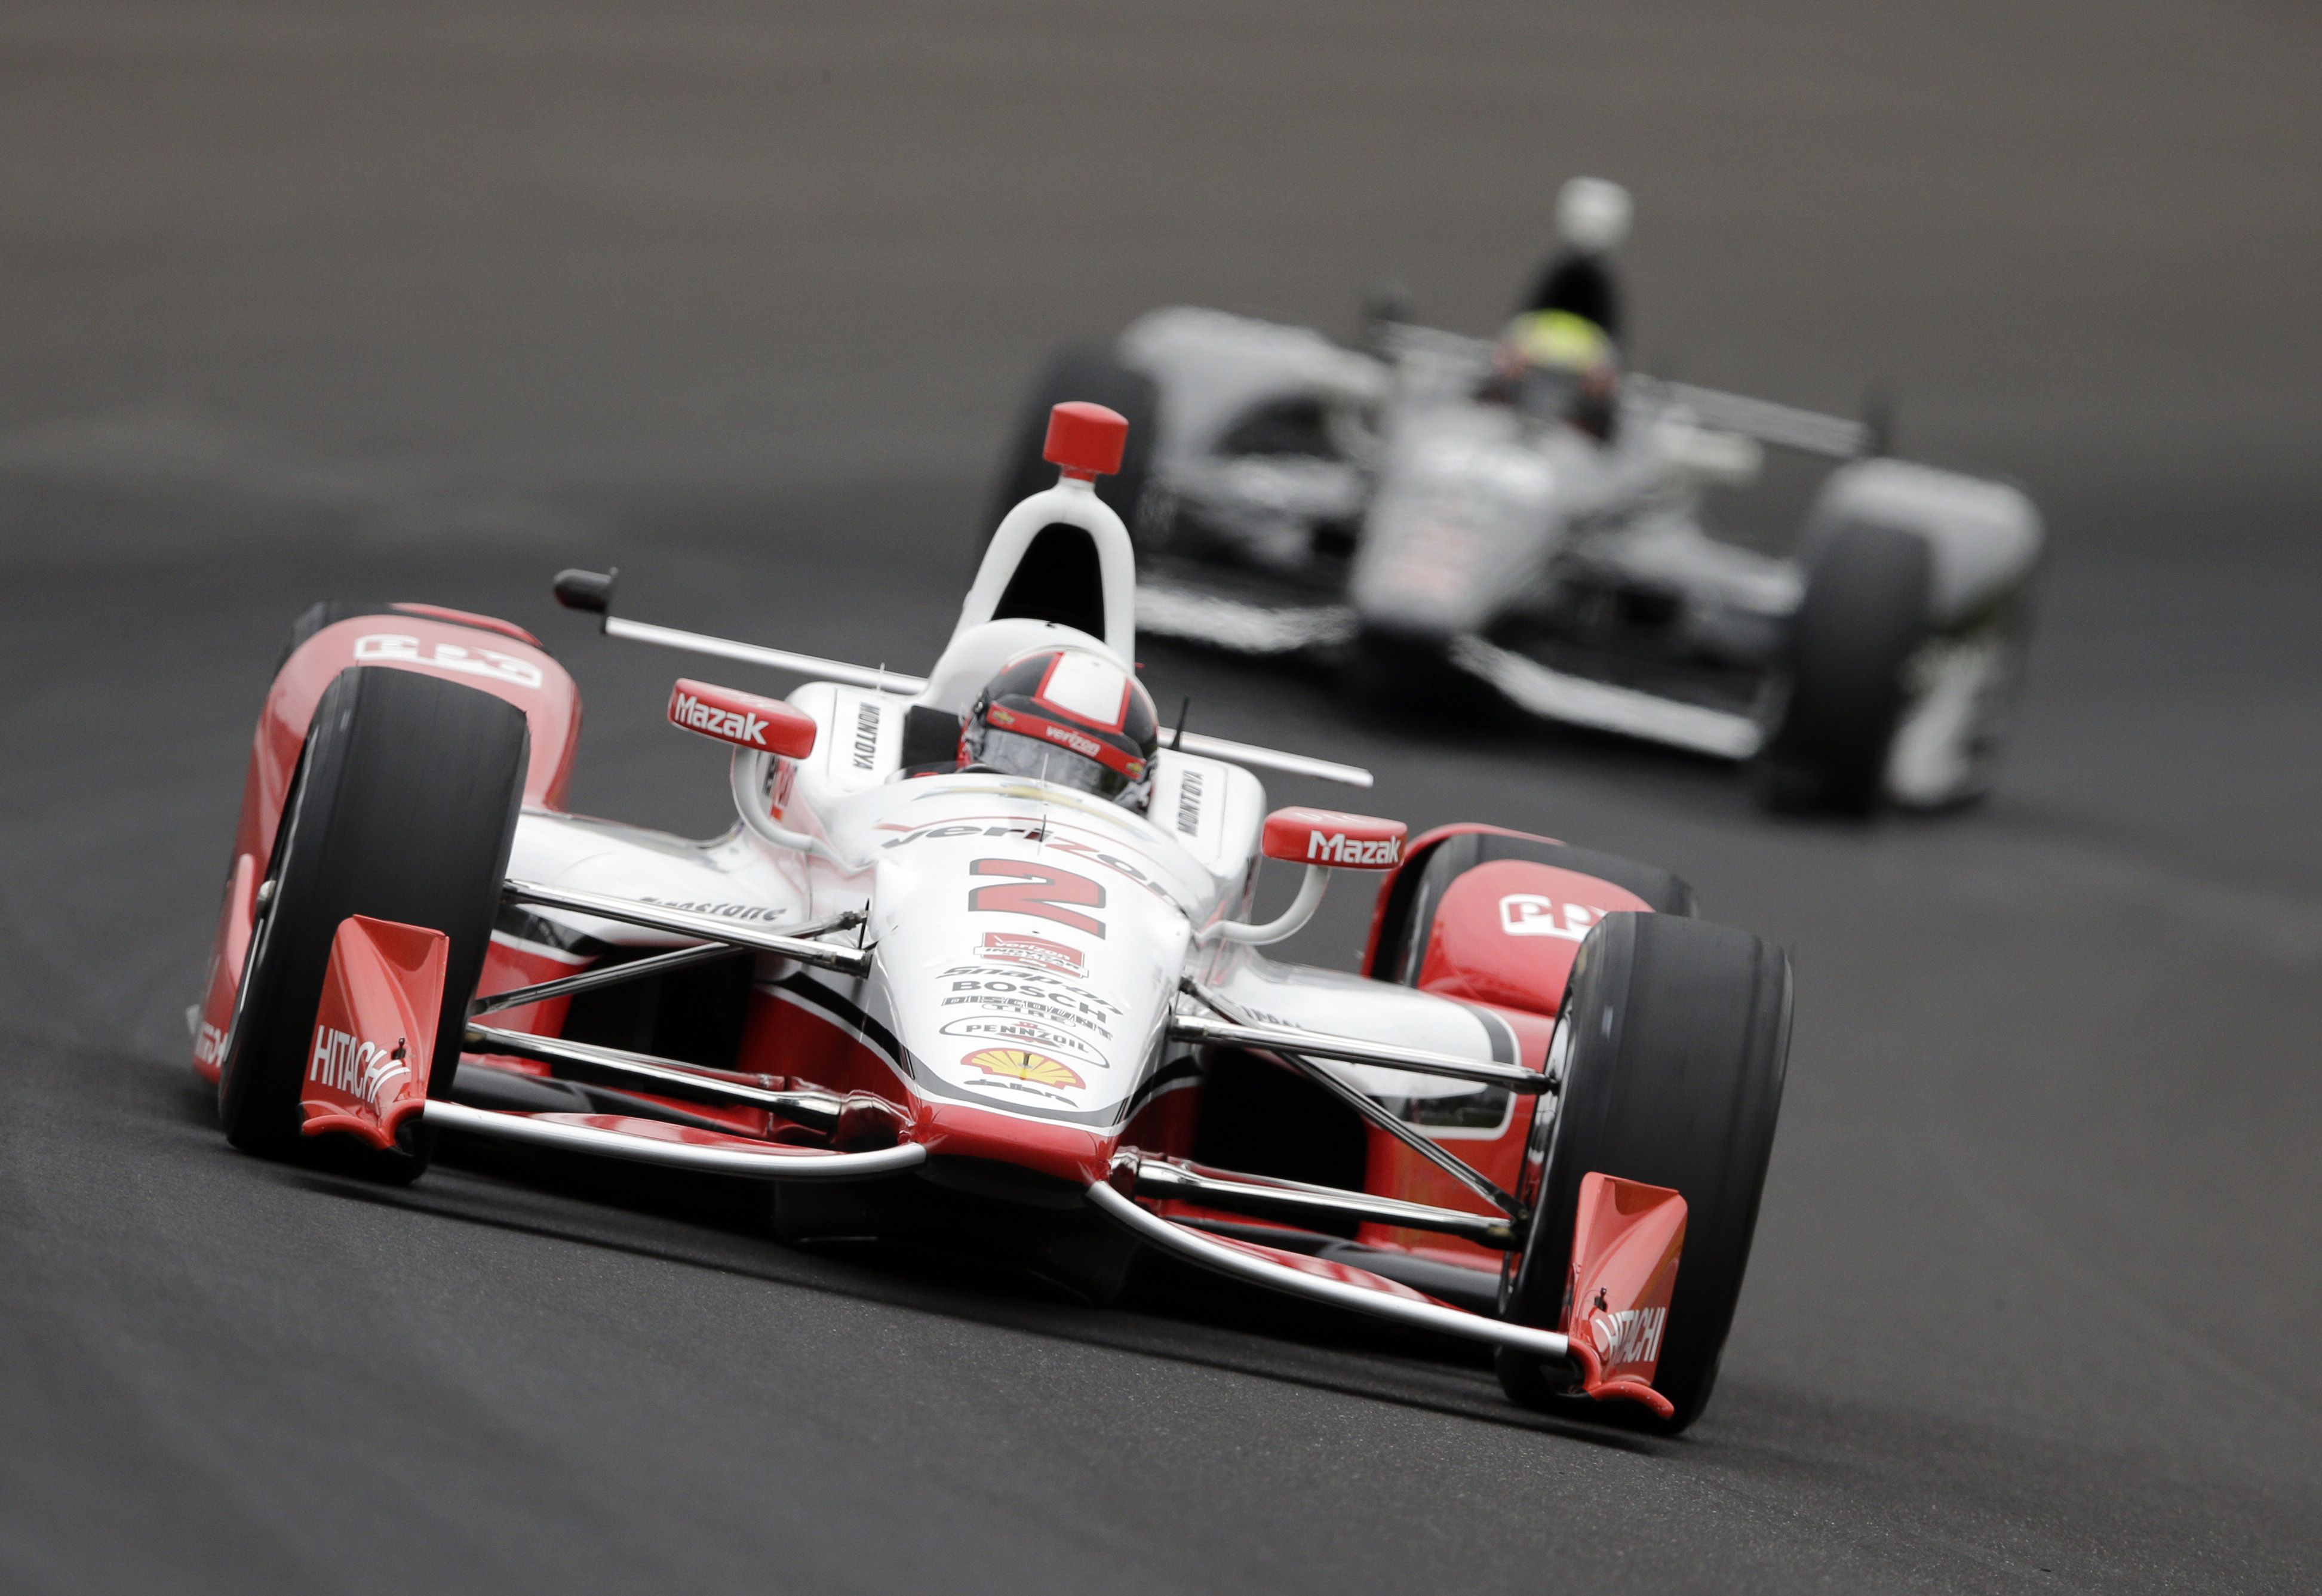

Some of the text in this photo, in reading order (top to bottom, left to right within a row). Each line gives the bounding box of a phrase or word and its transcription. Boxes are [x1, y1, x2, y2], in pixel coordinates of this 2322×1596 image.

[674, 692, 769, 745] Mazak
[853, 702, 880, 770] MONTOYA
[1045, 725, 1101, 758] verizon
[1175, 770, 1204, 837] MONTOYA
[1307, 830, 1401, 864] Mazak
[968, 858, 1106, 940] 2
[951, 980, 1107, 1024] BOSCH
[309, 1025, 411, 1104] HITACHI
[965, 1024, 1089, 1053] PENNZOIL
[1595, 1306, 1667, 1367] HITACHI
